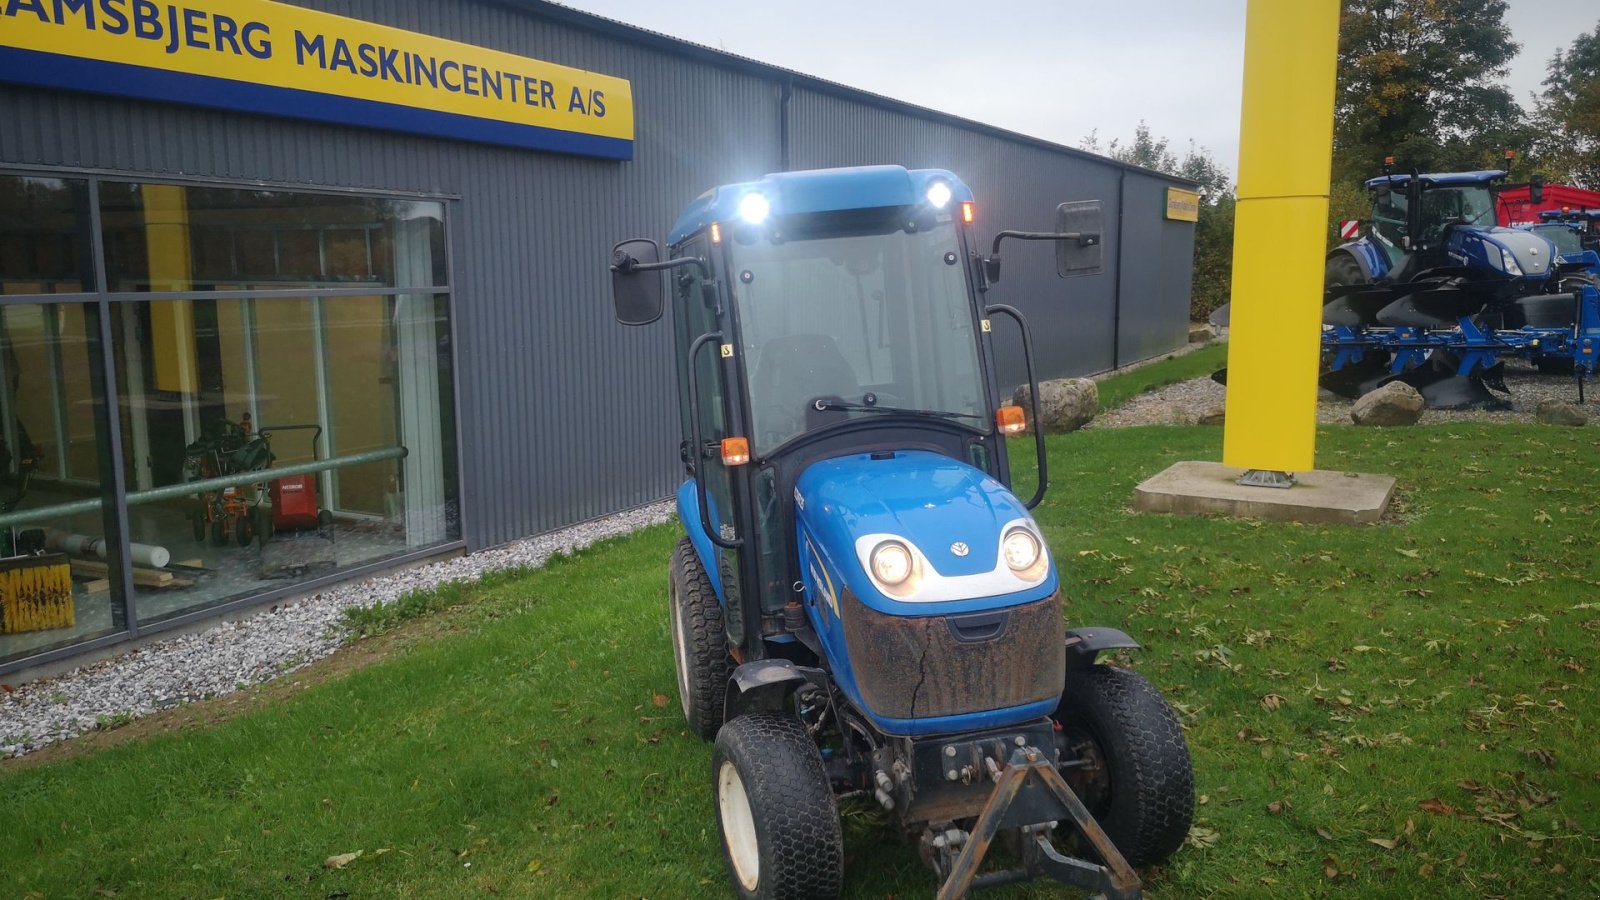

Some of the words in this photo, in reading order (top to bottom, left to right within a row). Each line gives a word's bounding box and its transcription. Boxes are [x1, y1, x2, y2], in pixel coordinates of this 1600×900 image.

[0, 0, 272, 59] AMSBJERG
[294, 30, 556, 110] MASKINCENTER
[568, 86, 606, 118] A/S
